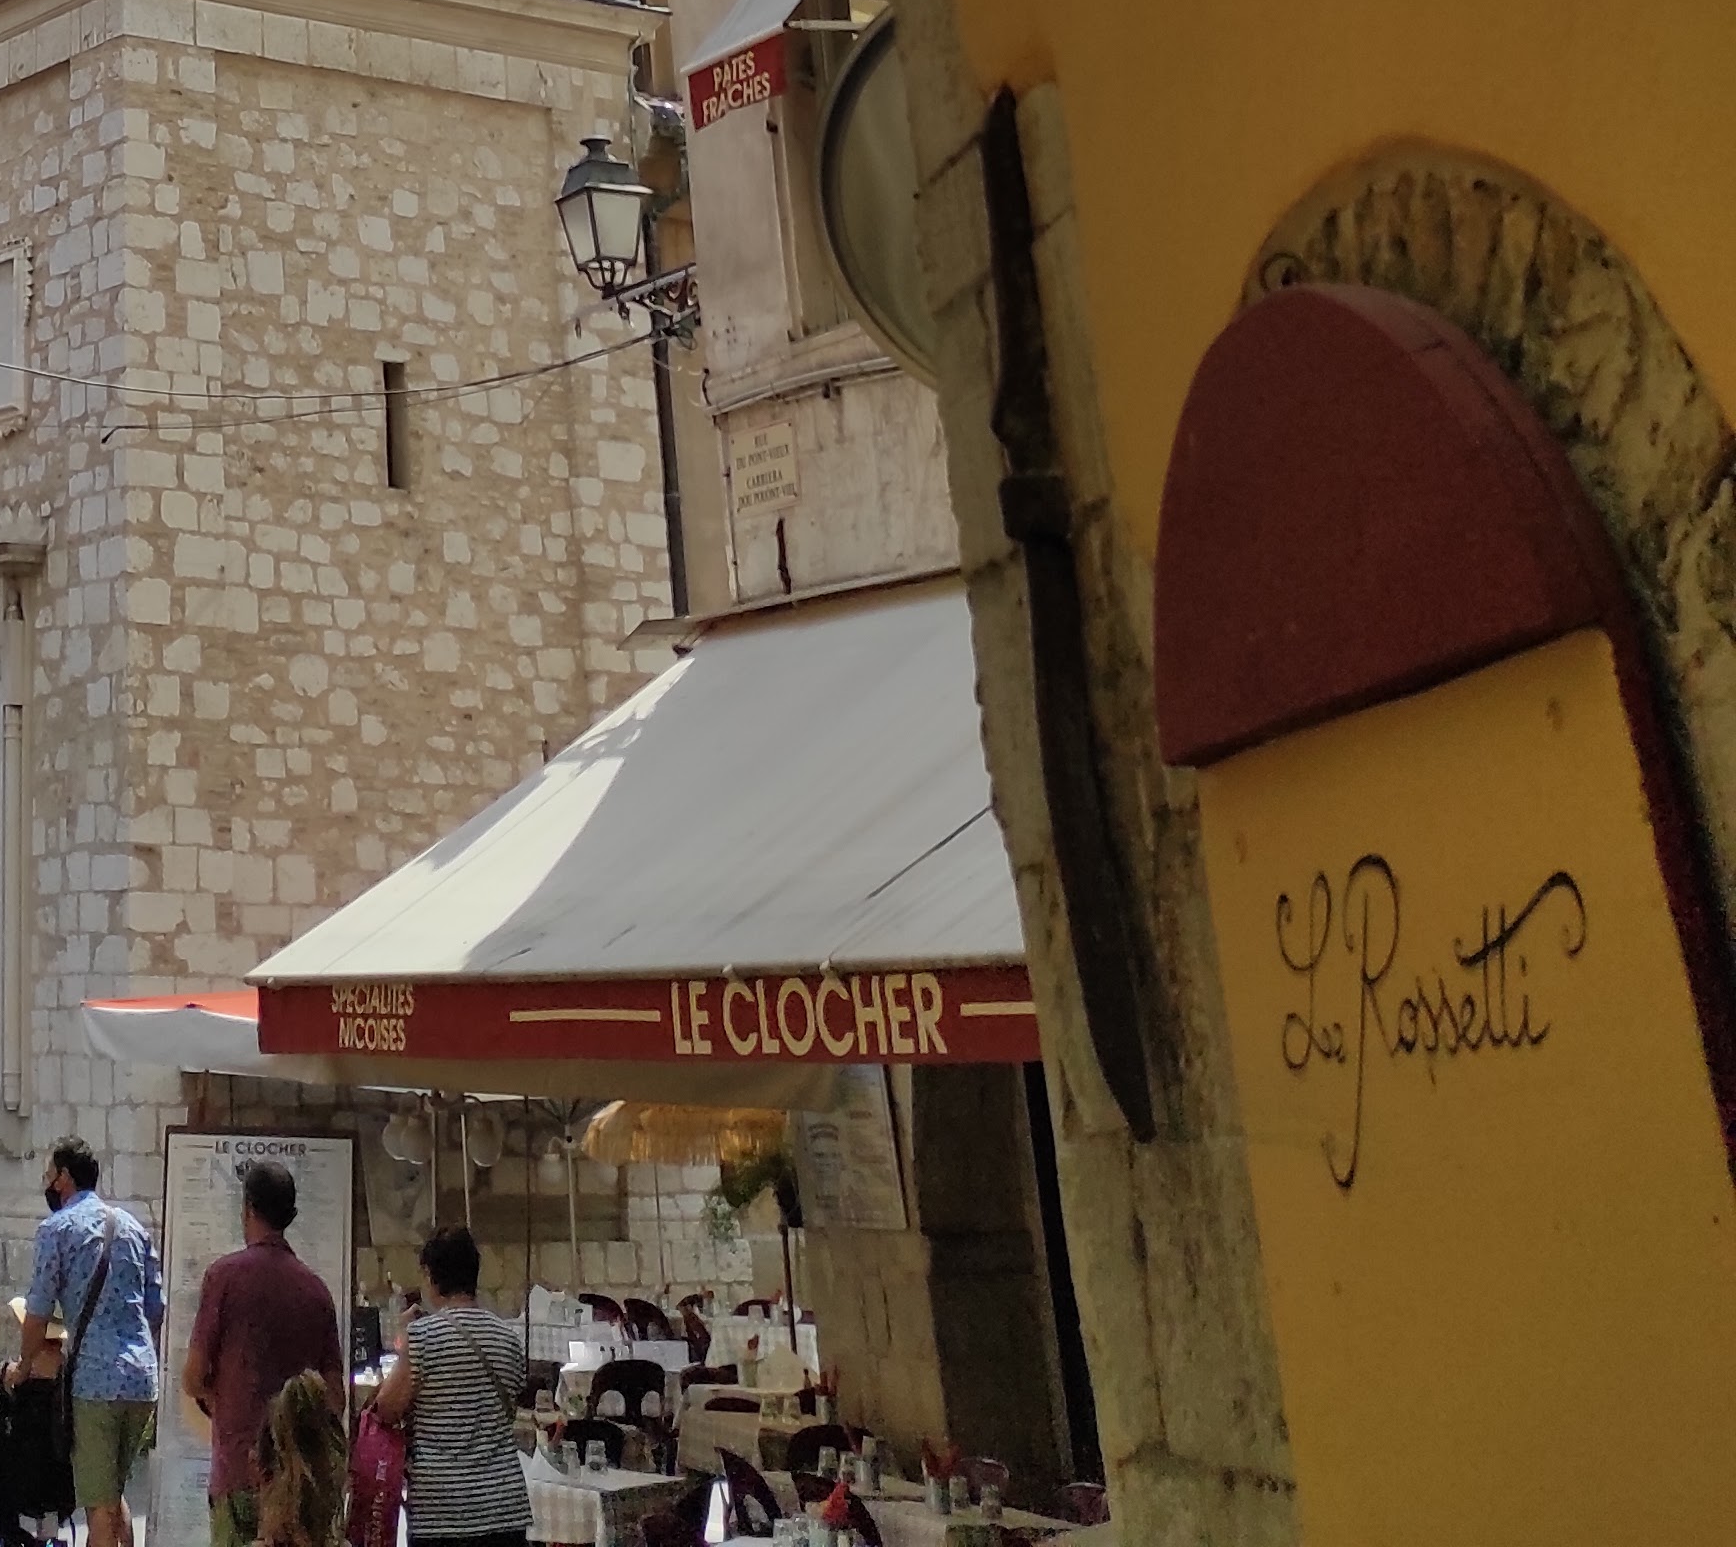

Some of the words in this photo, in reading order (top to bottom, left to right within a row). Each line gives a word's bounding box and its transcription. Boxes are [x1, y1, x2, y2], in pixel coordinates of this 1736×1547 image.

[670, 979, 713, 1055] LE
[722, 972, 949, 1057] CLOCHER
[1276, 869, 1347, 1071] Le
[1320, 853, 1588, 1189] Rossetti
[215, 1140, 231, 1154] LE
[234, 1141, 308, 1157] CLOCHER
